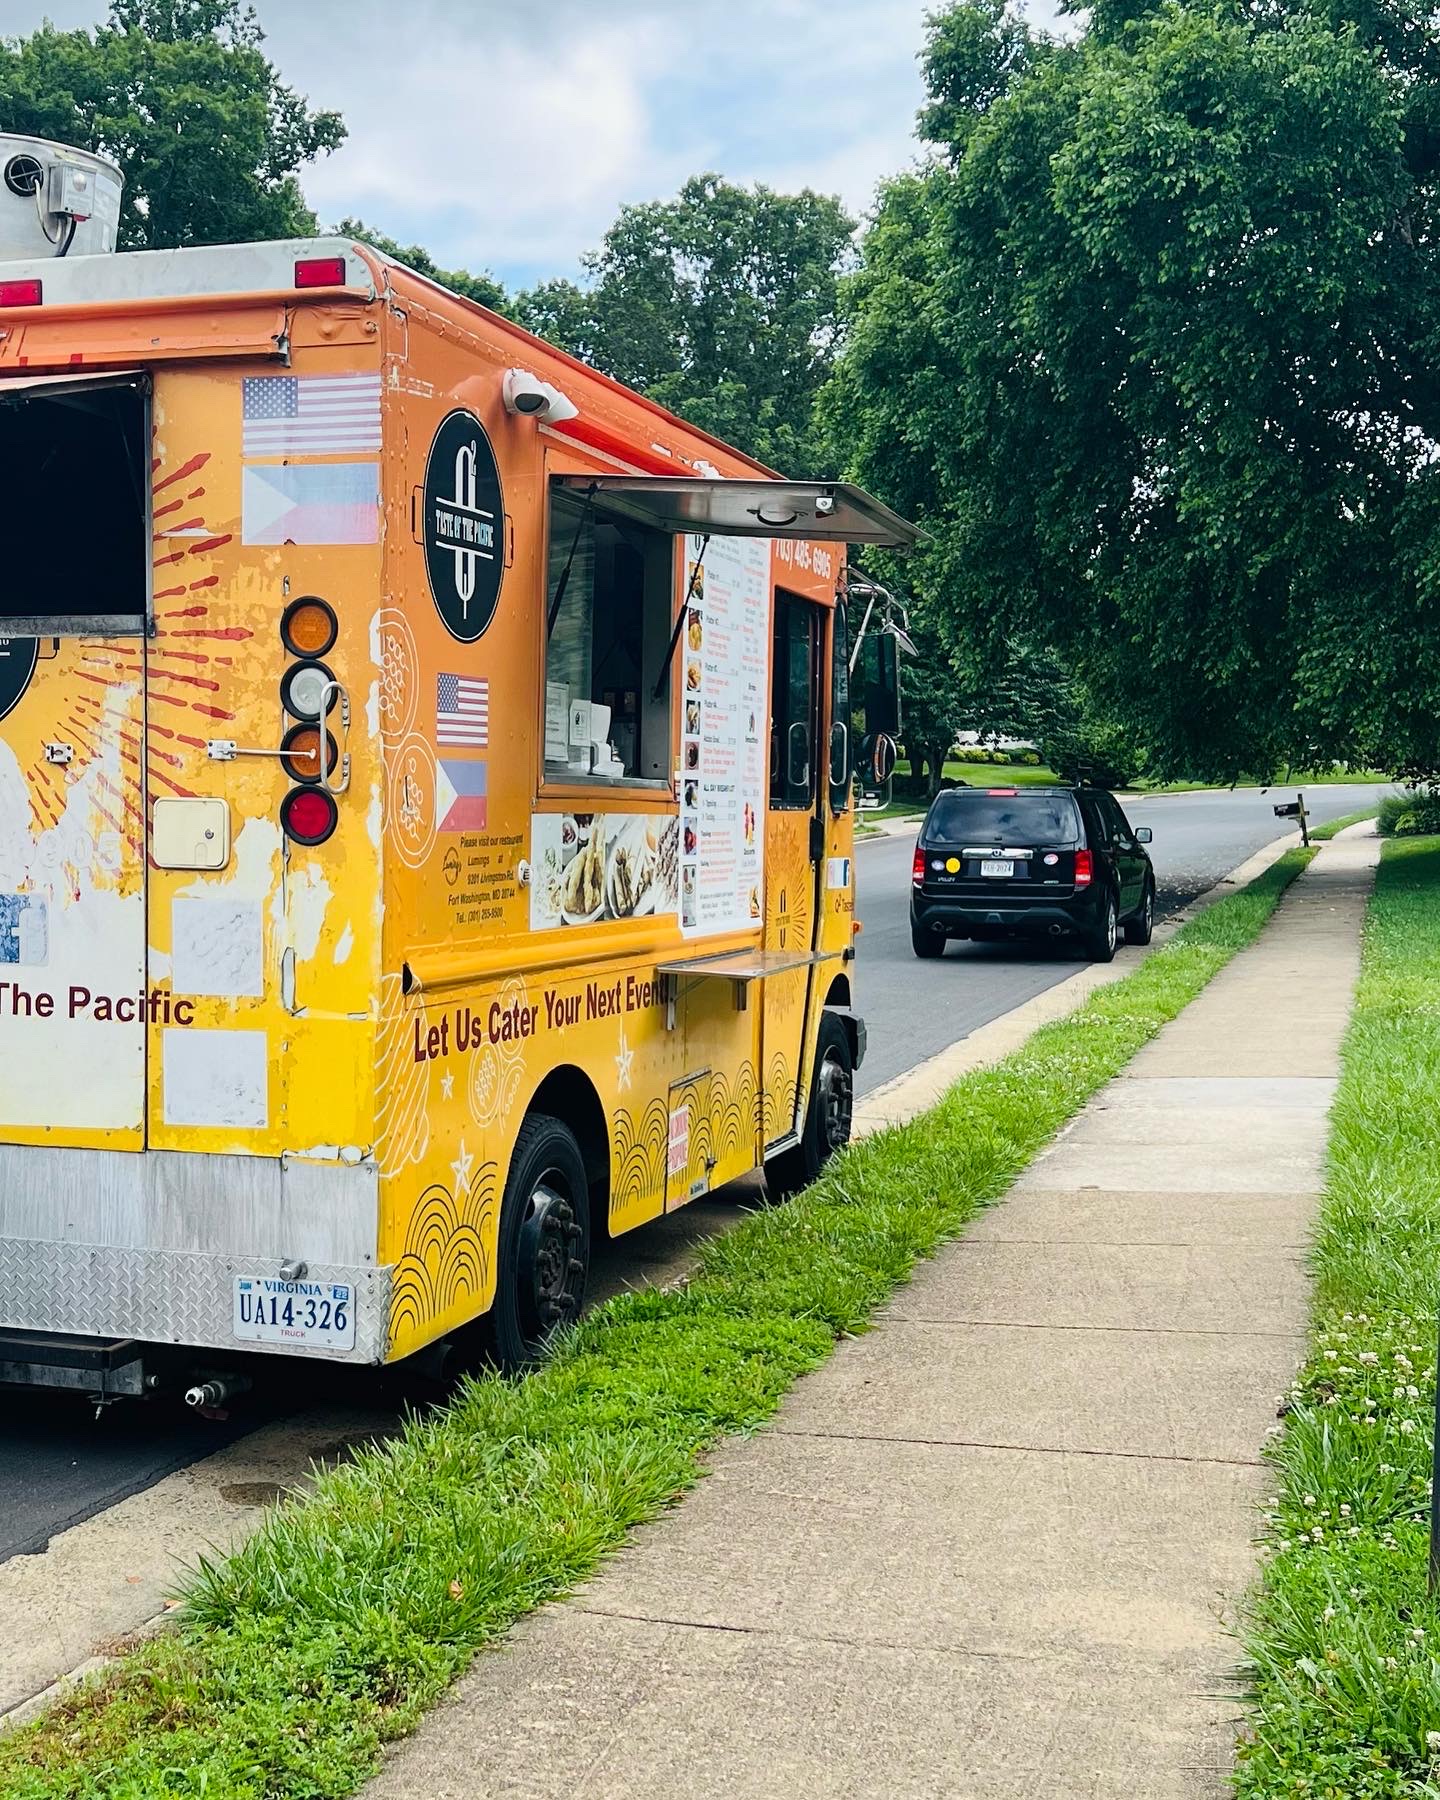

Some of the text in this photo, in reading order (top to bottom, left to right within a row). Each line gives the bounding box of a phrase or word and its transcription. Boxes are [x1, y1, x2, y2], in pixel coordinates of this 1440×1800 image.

[435, 509, 454, 538] TASTE
[460, 834, 524, 848] Please visit our restaurant
[467, 854, 504, 867] Lumings at
[448, 894, 460, 906] Fort
[492, 889, 501, 900] MD
[467, 909, 481, 924] (301)
[68, 986, 195, 1025] Pacific
[414, 1014, 448, 1063] Let
[456, 1008, 482, 1052] Us
[488, 1002, 539, 1044] Cater
[544, 990, 583, 1029] Your
[586, 980, 622, 1020] Next
[264, 1280, 323, 1296] VIRGINIA
[240, 1293, 348, 1331] UA14-326
[280, 1329, 306, 1338] TRUCK
